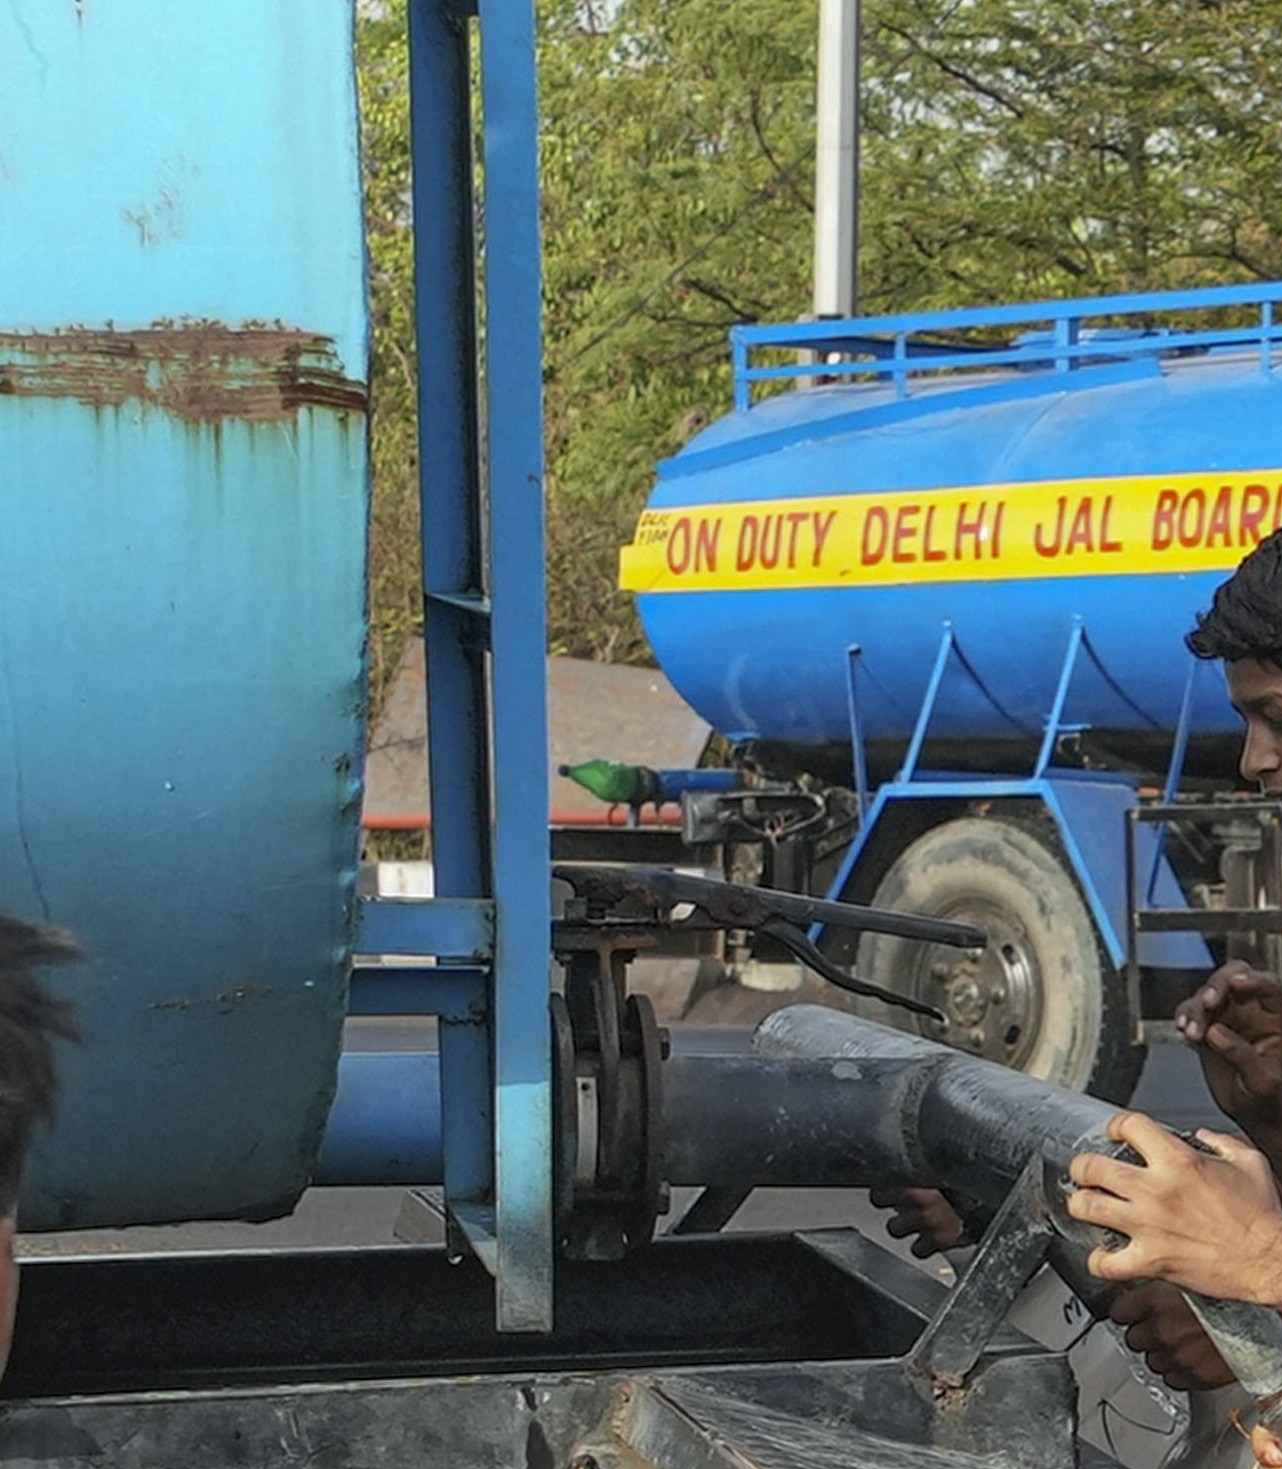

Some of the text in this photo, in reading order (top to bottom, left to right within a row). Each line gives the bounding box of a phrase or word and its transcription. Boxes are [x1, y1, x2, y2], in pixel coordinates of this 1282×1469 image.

[667, 517, 723, 576] ON
[736, 510, 837, 573] DUTY
[861, 501, 1005, 567] DELHI
[1033, 495, 1123, 558] JAL
